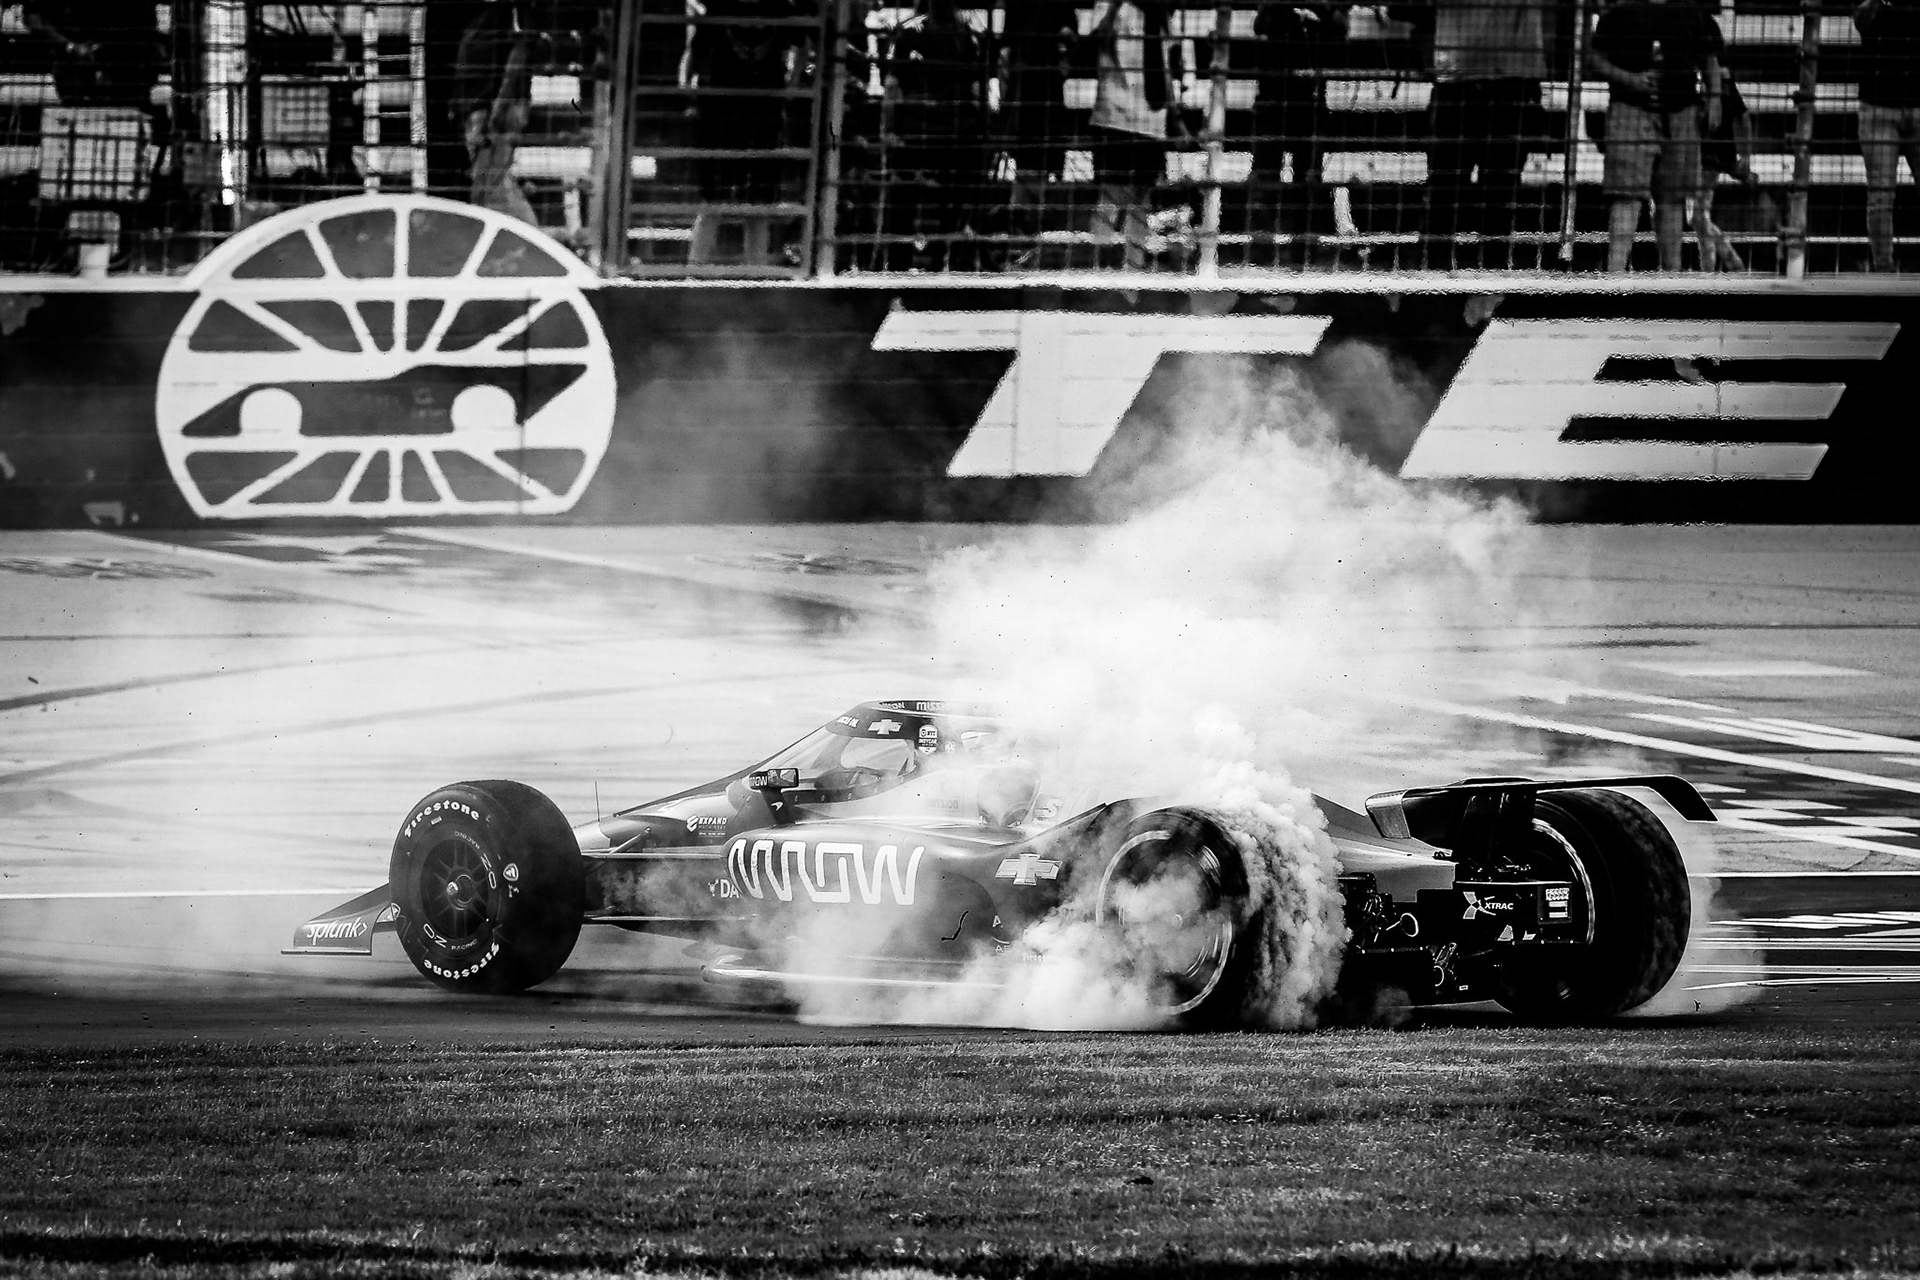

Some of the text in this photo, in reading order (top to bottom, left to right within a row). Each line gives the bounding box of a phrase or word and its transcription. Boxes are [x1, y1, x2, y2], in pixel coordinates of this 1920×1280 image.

[404, 800, 480, 838] Firestone
[698, 817, 727, 825] EXPAND
[1484, 902, 1514, 910] XTRAC
[424, 941, 500, 980] Firestone
